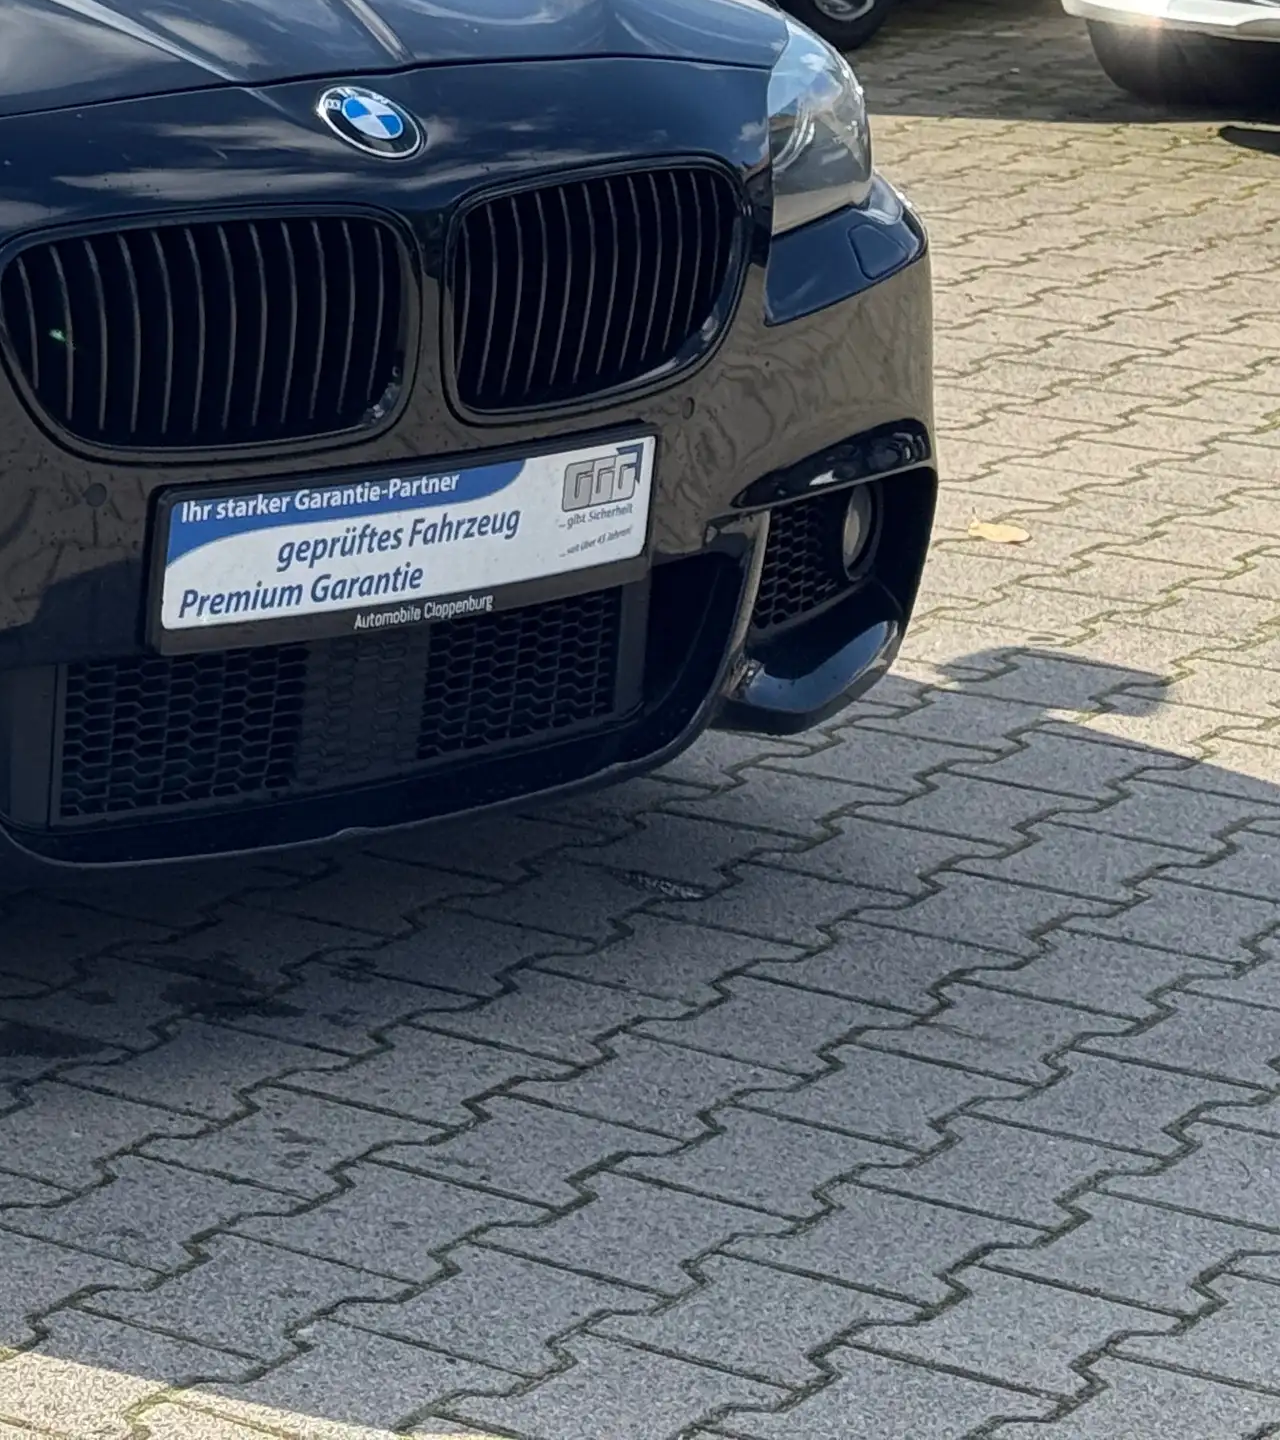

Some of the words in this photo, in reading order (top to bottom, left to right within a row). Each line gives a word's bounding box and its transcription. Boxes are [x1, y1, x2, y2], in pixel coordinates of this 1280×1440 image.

[182, 500, 212, 523] Ihr
[216, 494, 291, 520] starker
[295, 474, 460, 510] Garantie-Partner
[276, 523, 404, 572] geprüftes
[408, 509, 521, 547] Fahrzeug
[178, 580, 303, 618] Premium
[311, 562, 423, 603] Garantie
[354, 606, 421, 630] Automobile
[424, 595, 494, 619] Cloppenburg
